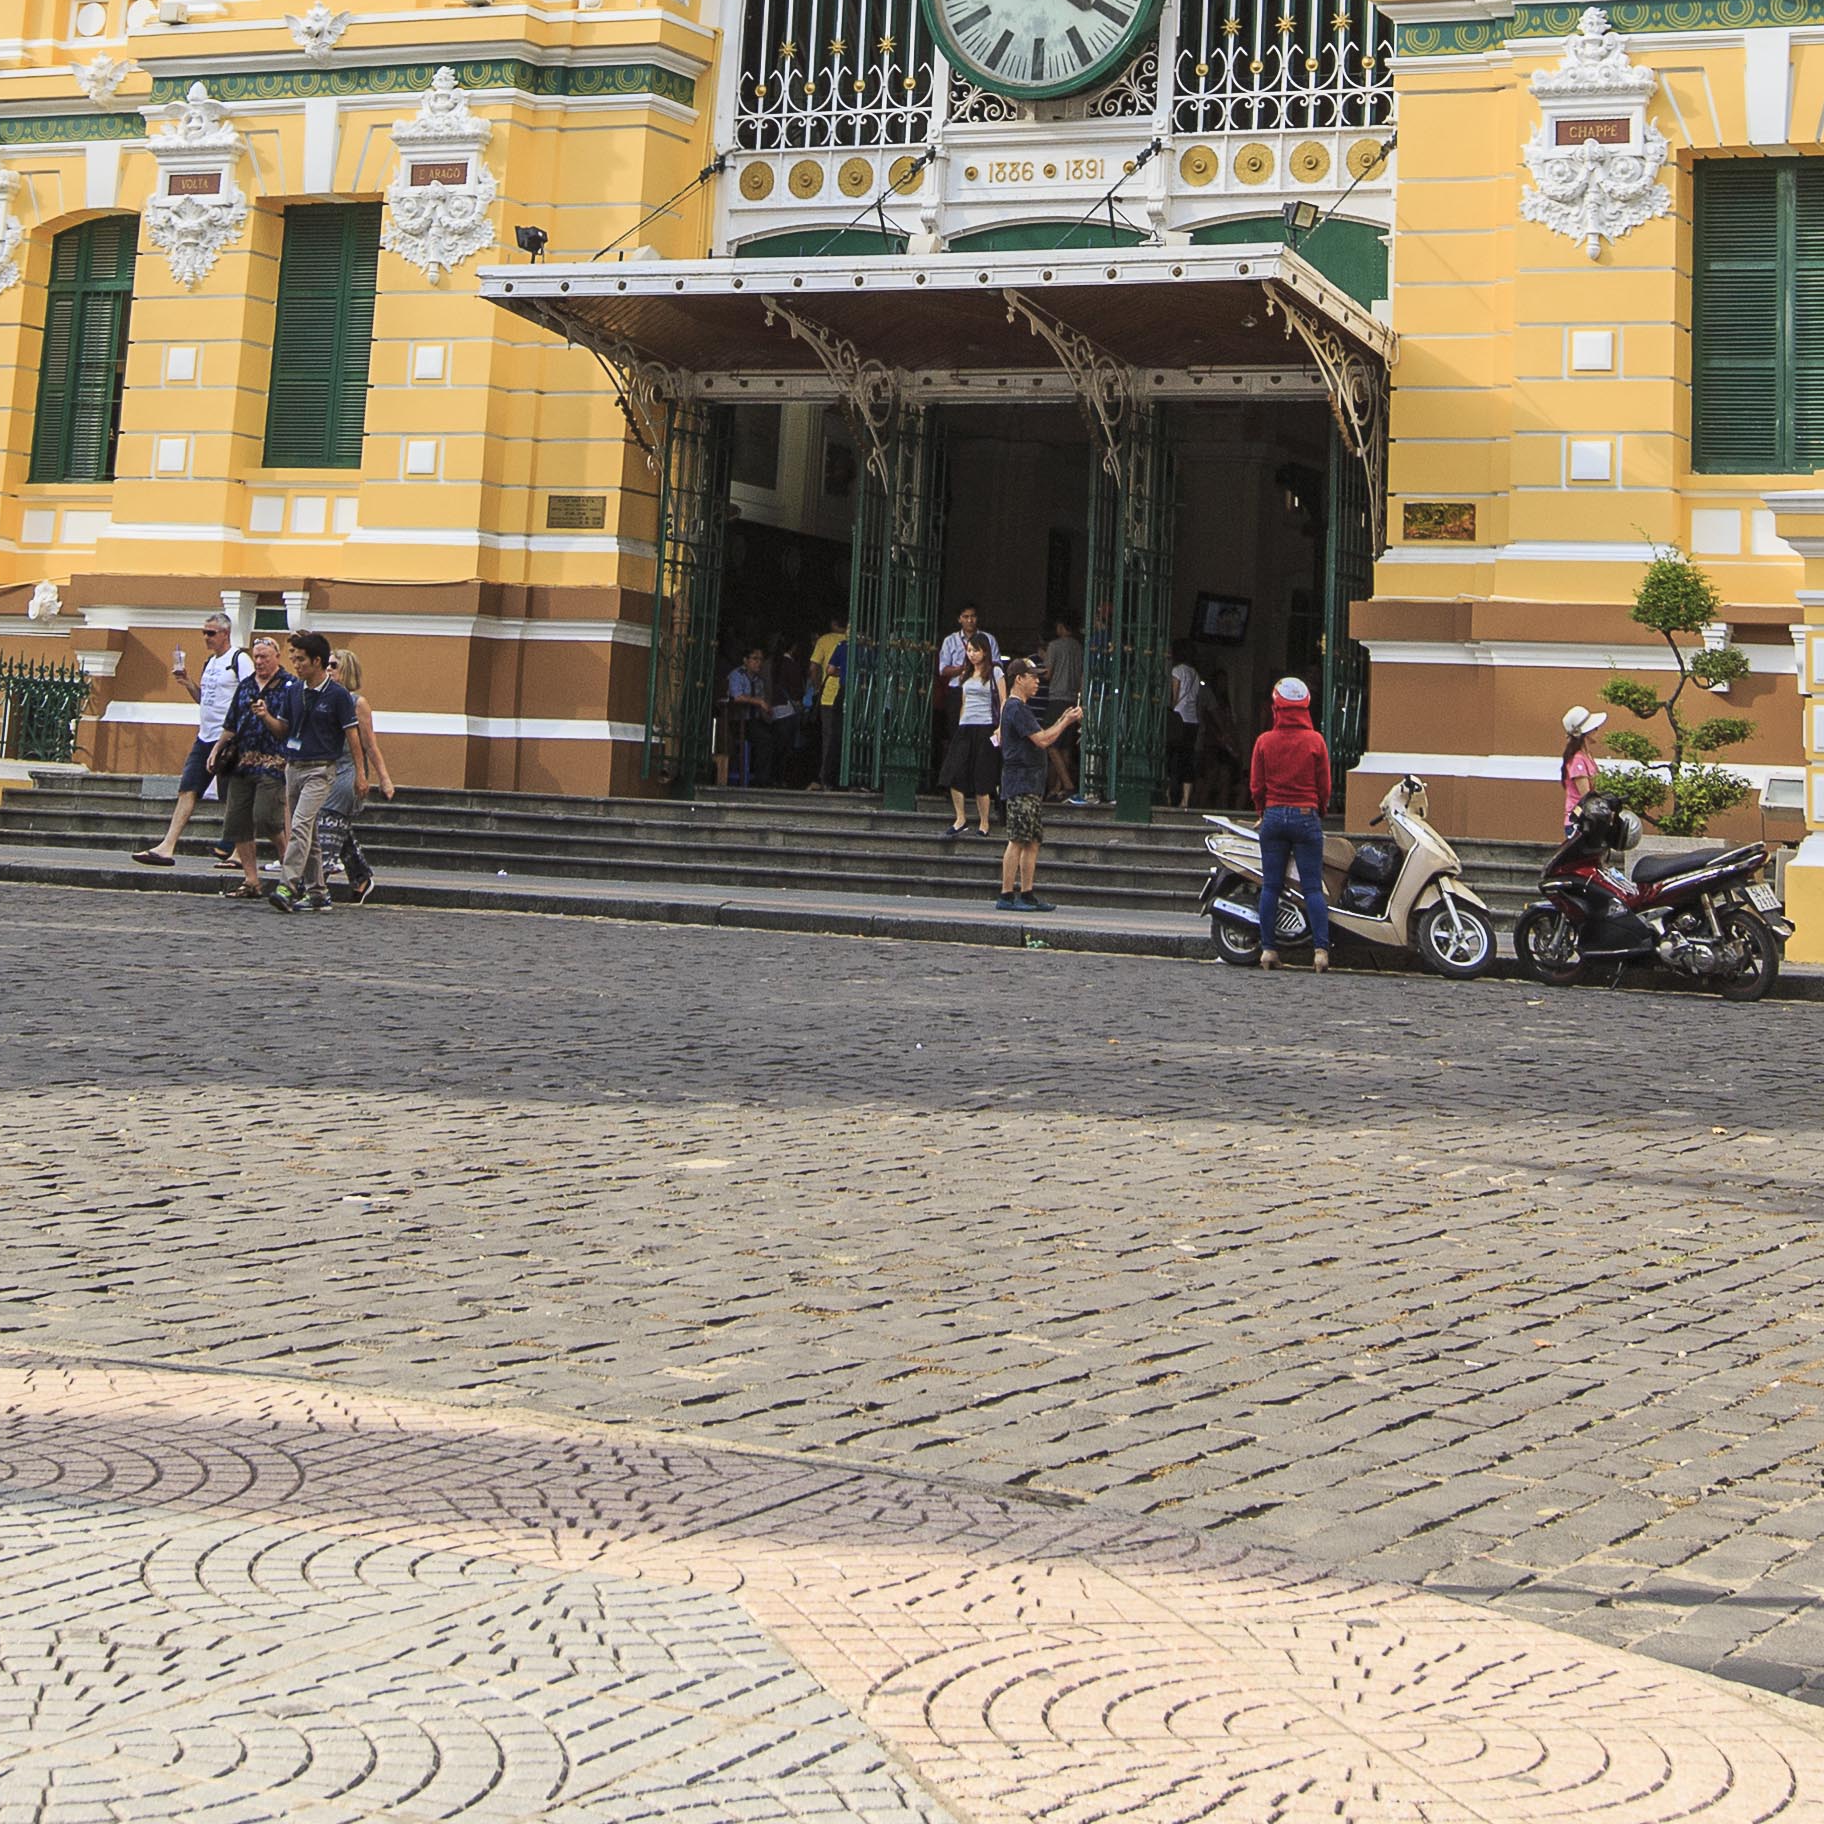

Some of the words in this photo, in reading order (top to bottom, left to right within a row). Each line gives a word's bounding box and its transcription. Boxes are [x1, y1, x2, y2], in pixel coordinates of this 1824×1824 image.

[1569, 124, 1618, 138] CHAPPE
[429, 167, 461, 180] ARAGO
[988, 160, 1034, 183] 1886
[1065, 158, 1105, 181] 1891
[181, 177, 209, 190] VOLTA
